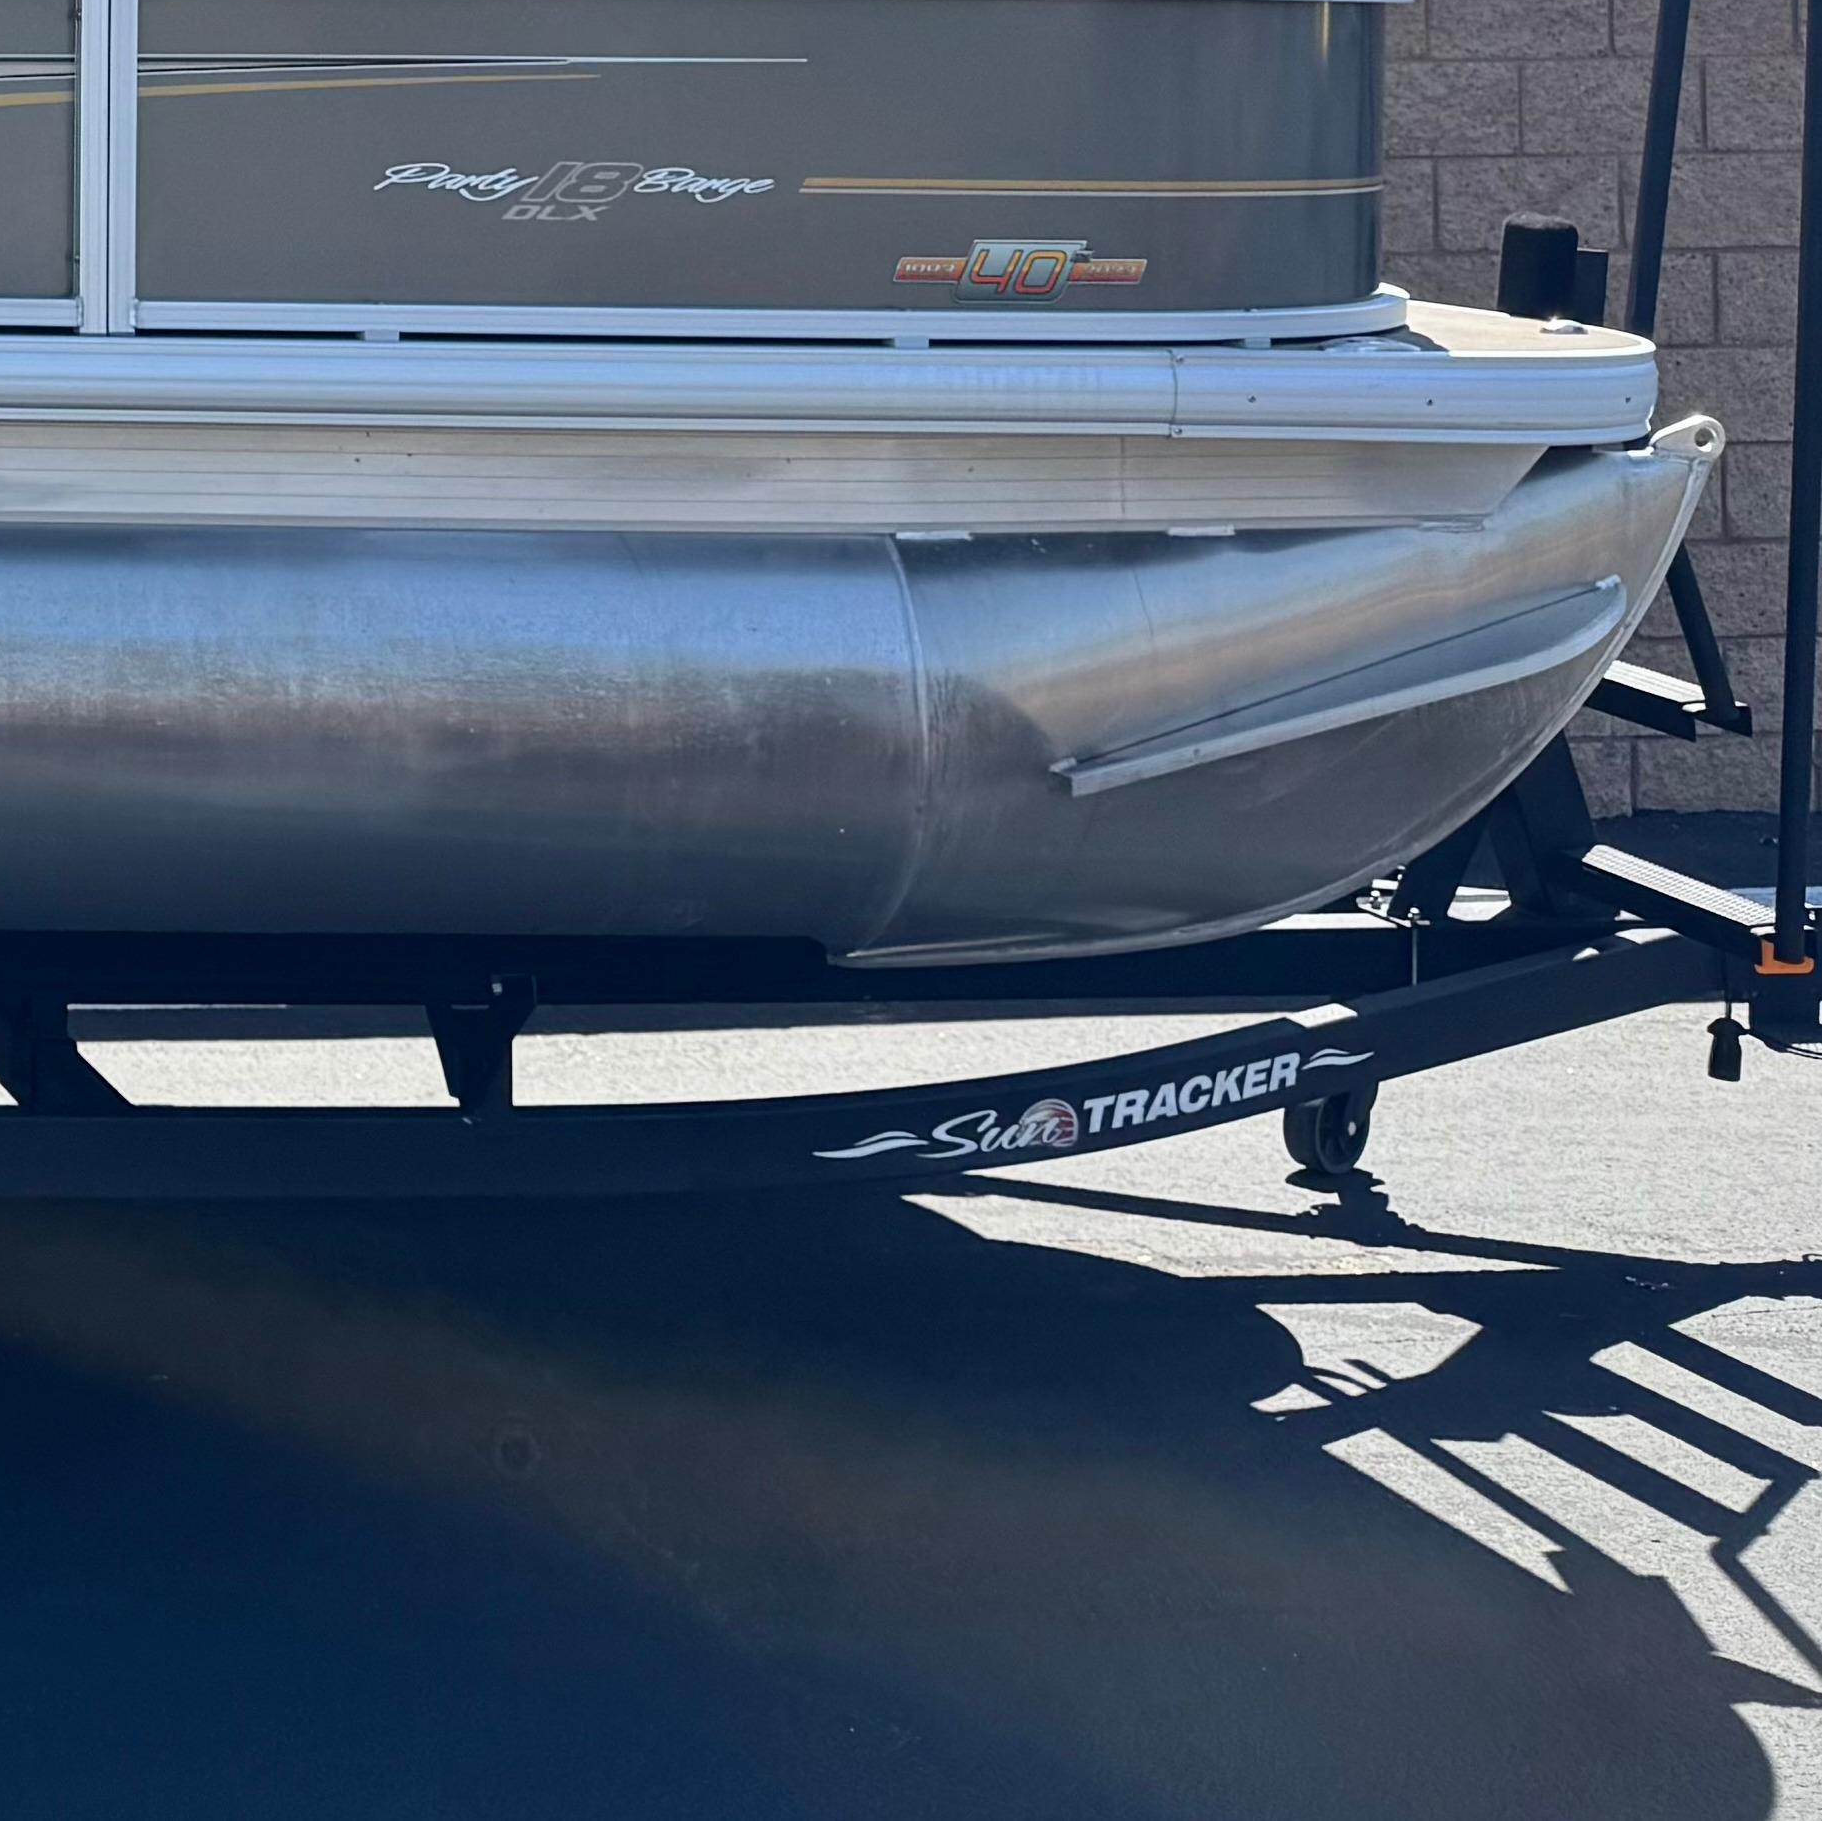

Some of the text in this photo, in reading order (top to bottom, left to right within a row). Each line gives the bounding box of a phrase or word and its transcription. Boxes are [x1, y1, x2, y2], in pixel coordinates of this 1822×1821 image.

[373, 161, 776, 204] Party 18 Barge
[501, 204, 611, 221] DLX
[969, 248, 1068, 295] 40
[915, 1052, 1301, 1159] Sun TRACKER
